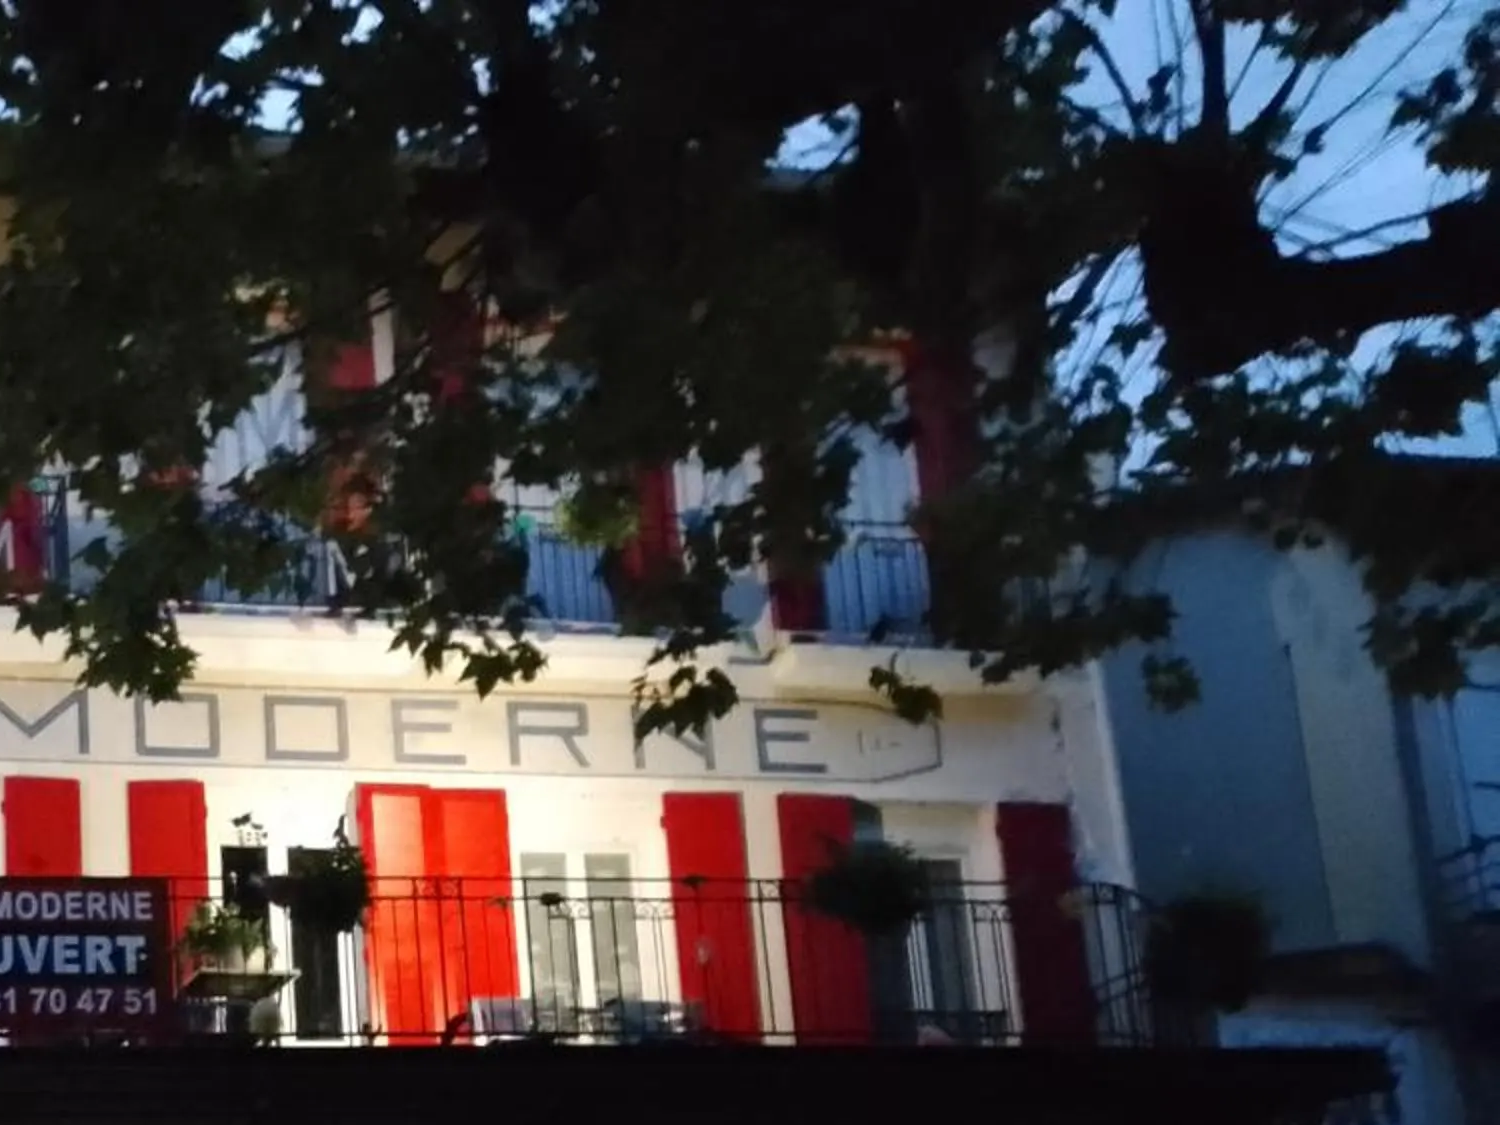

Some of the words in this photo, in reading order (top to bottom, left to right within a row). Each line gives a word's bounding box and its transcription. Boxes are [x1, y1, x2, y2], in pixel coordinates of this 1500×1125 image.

[28, 986, 67, 1015] 70
[76, 986, 113, 1015] 47
[123, 986, 157, 1015] 51
